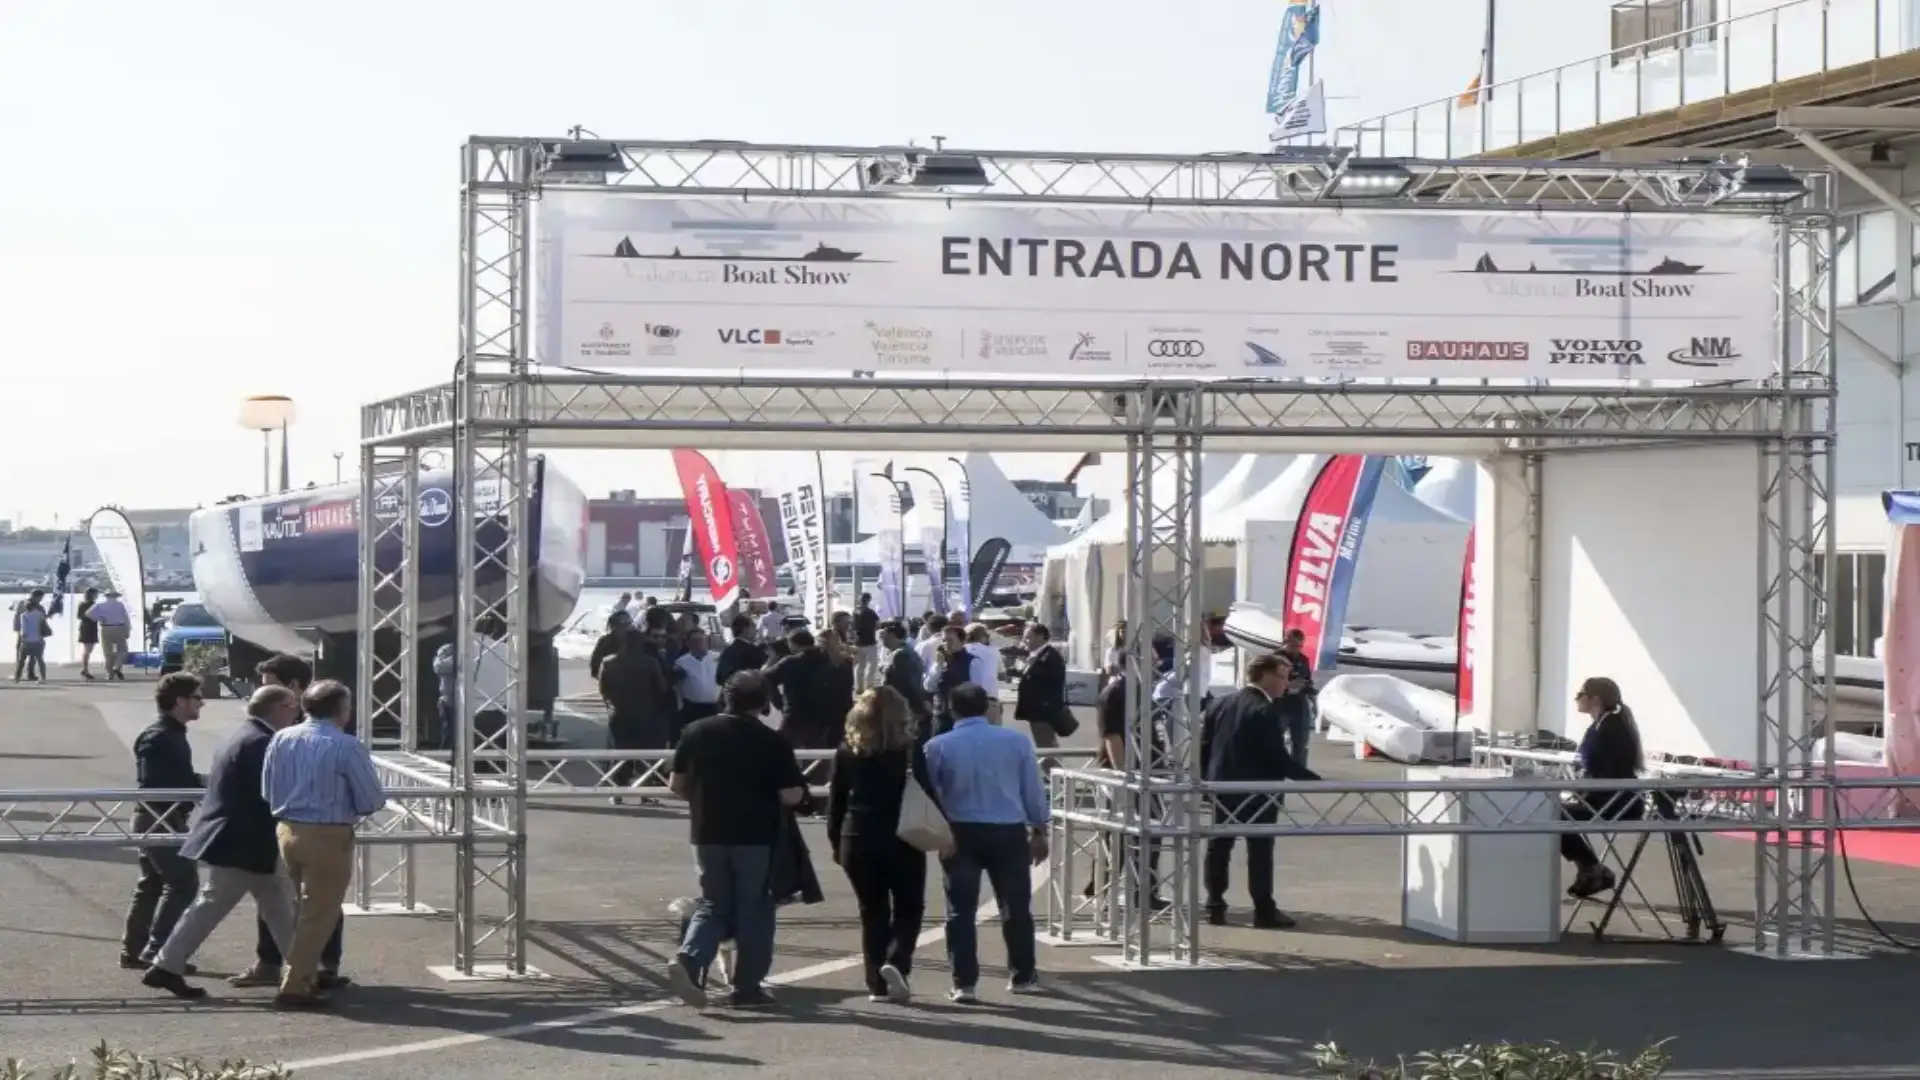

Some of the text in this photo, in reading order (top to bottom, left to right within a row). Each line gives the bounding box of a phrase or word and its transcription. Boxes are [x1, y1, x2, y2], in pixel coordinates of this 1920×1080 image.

[942, 237, 1398, 283] ENTRADA NORTE
[723, 263, 777, 284] Boat
[784, 264, 851, 285] Show
[1575, 278, 1626, 297] Boat
[1631, 278, 1695, 298] Show
[718, 328, 761, 344] VLC
[1549, 339, 1644, 351] VOLVO
[1408, 342, 1528, 359] BAUHAUS
[1690, 336, 1732, 357] NM
[1549, 352, 1645, 365] PENTA
[1292, 511, 1343, 622] SELVA
